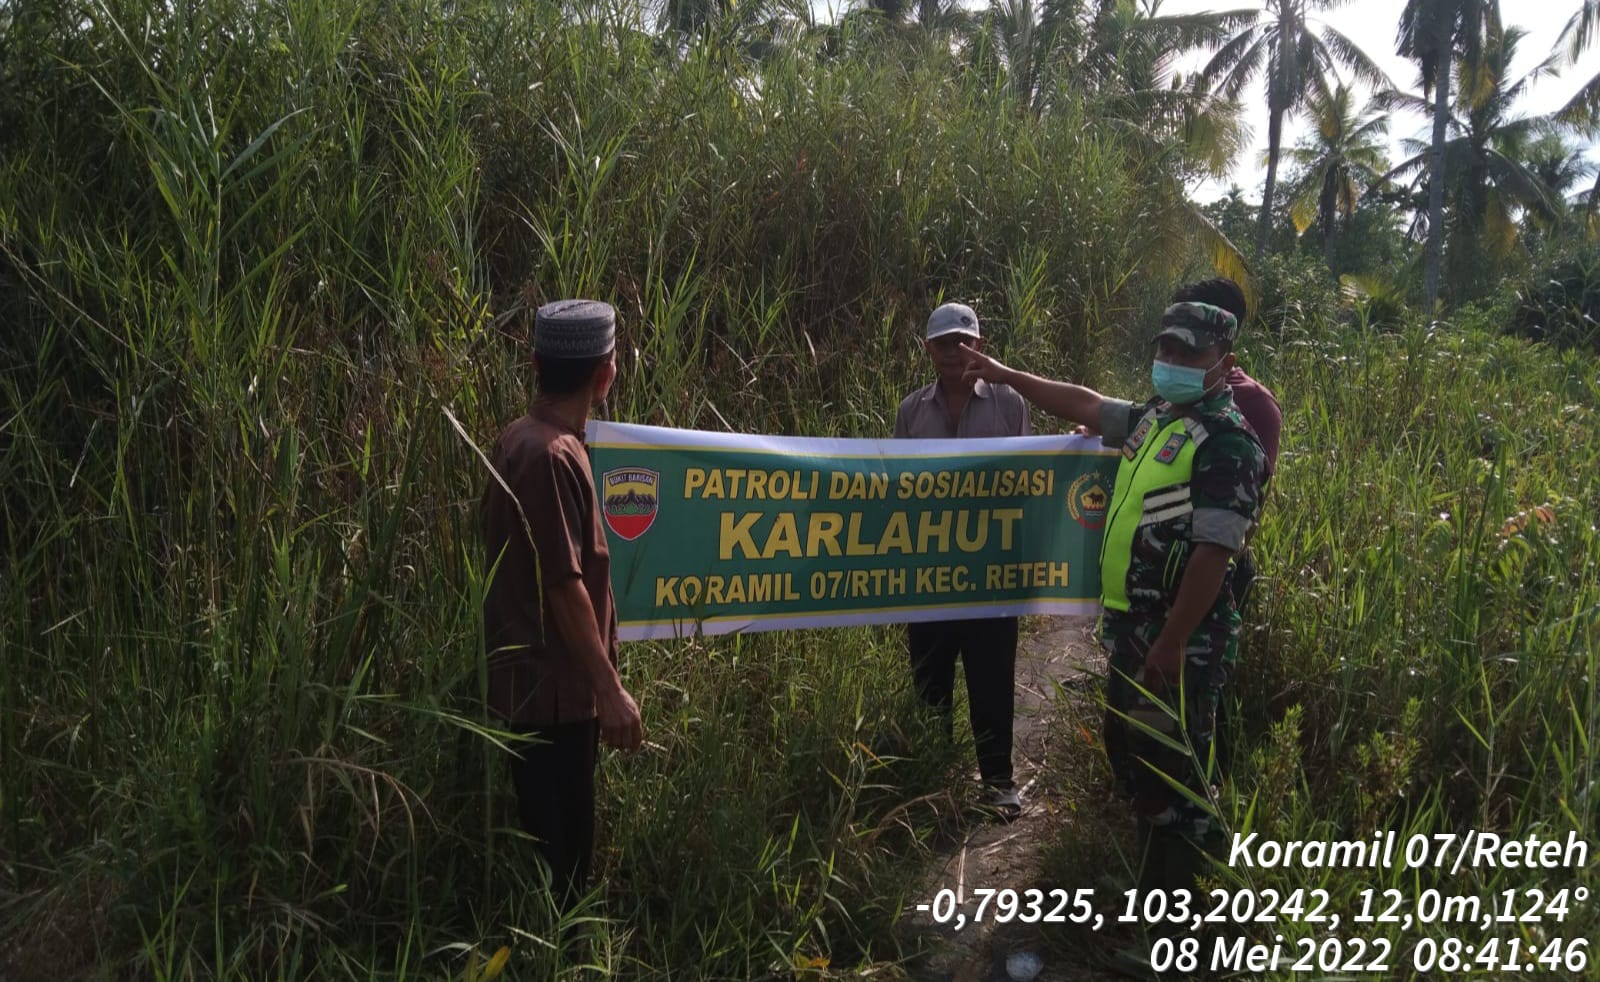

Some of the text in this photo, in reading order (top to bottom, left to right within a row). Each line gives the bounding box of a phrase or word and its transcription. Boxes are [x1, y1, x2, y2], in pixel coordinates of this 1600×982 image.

[684, 468, 1055, 500] PATROLI DAN SOSIALISASI
[719, 508, 1024, 560] KARLAHUT
[655, 561, 1069, 607] KORAMIL 07/RTH KEC. RETEH
